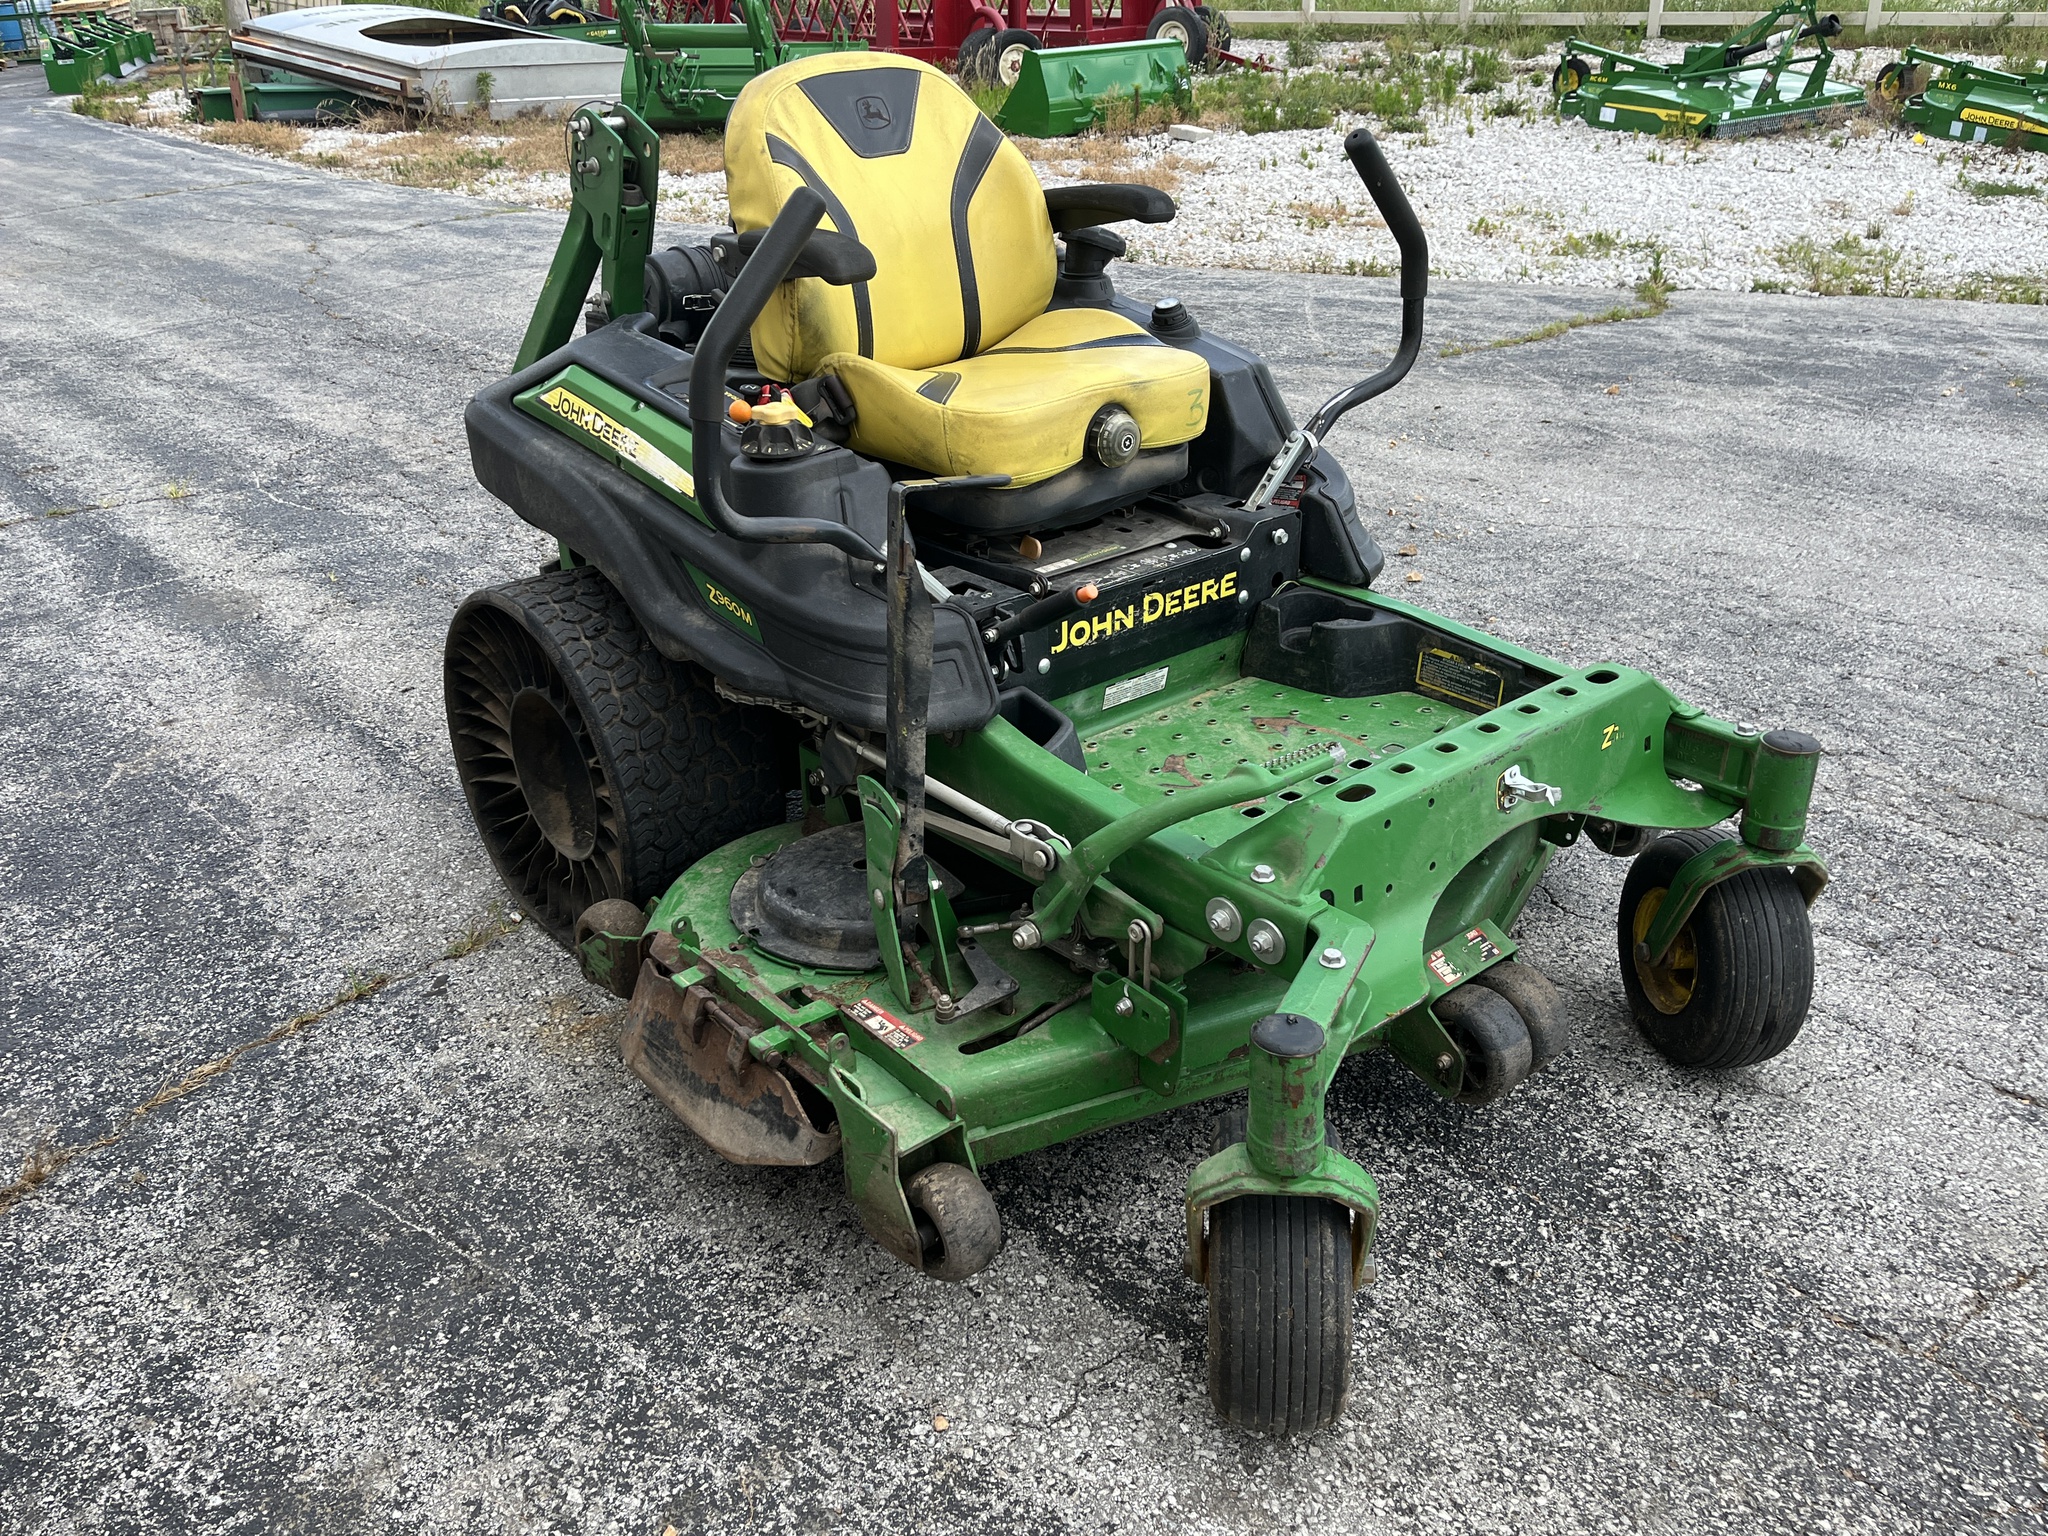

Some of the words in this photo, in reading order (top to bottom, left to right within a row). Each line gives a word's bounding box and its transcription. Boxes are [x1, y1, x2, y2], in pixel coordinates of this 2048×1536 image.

[1937, 81, 1957, 91] MX6
[1965, 112, 1987, 123] JOHN
[1988, 115, 2015, 129] DEERE
[551, 391, 592, 434] JOHN
[1185, 388, 1205, 427] 3
[704, 582, 754, 627] Z960M
[1051, 603, 1135, 655] JOHN
[1142, 571, 1238, 625] DEERE
